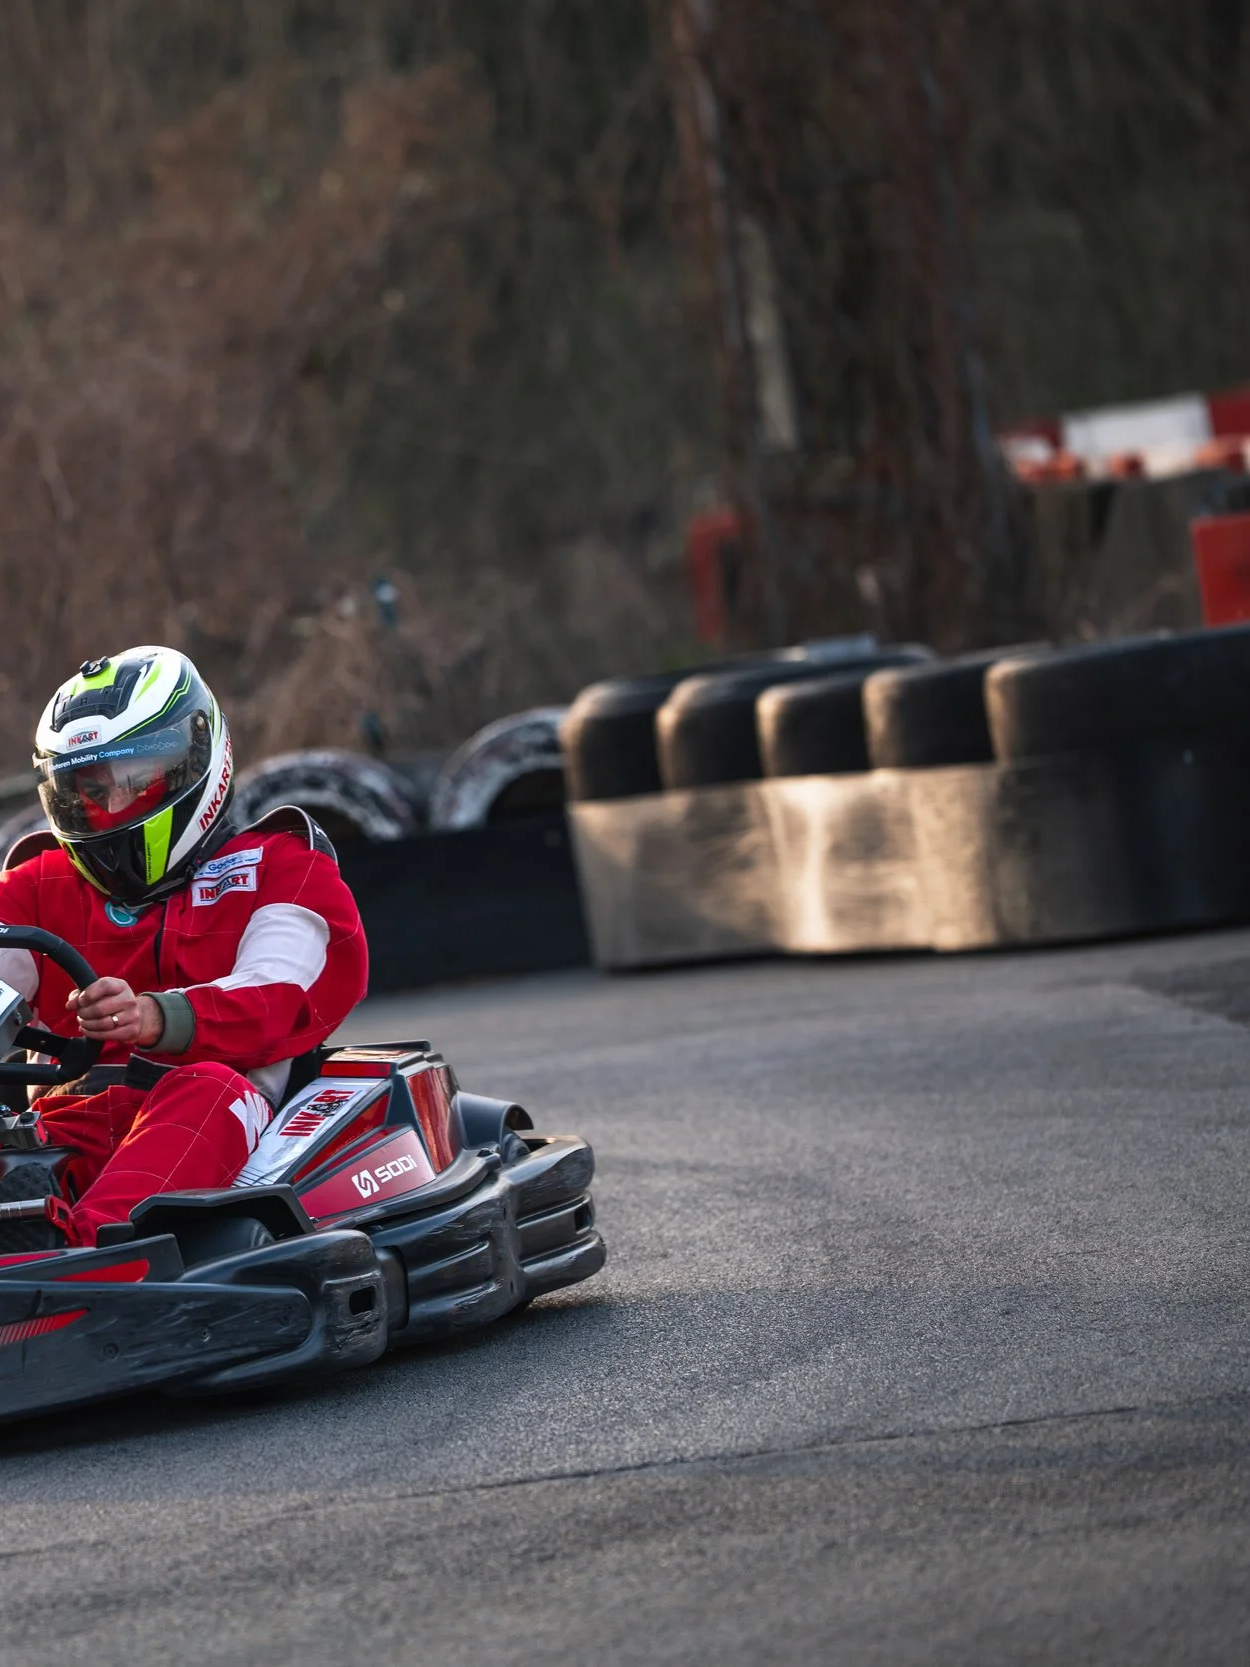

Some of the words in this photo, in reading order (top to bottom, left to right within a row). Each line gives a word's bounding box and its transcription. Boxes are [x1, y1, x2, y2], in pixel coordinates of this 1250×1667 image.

[71, 753, 99, 766] Mobility
[99, 746, 135, 759] Company
[374, 1154, 418, 1184] SODI
